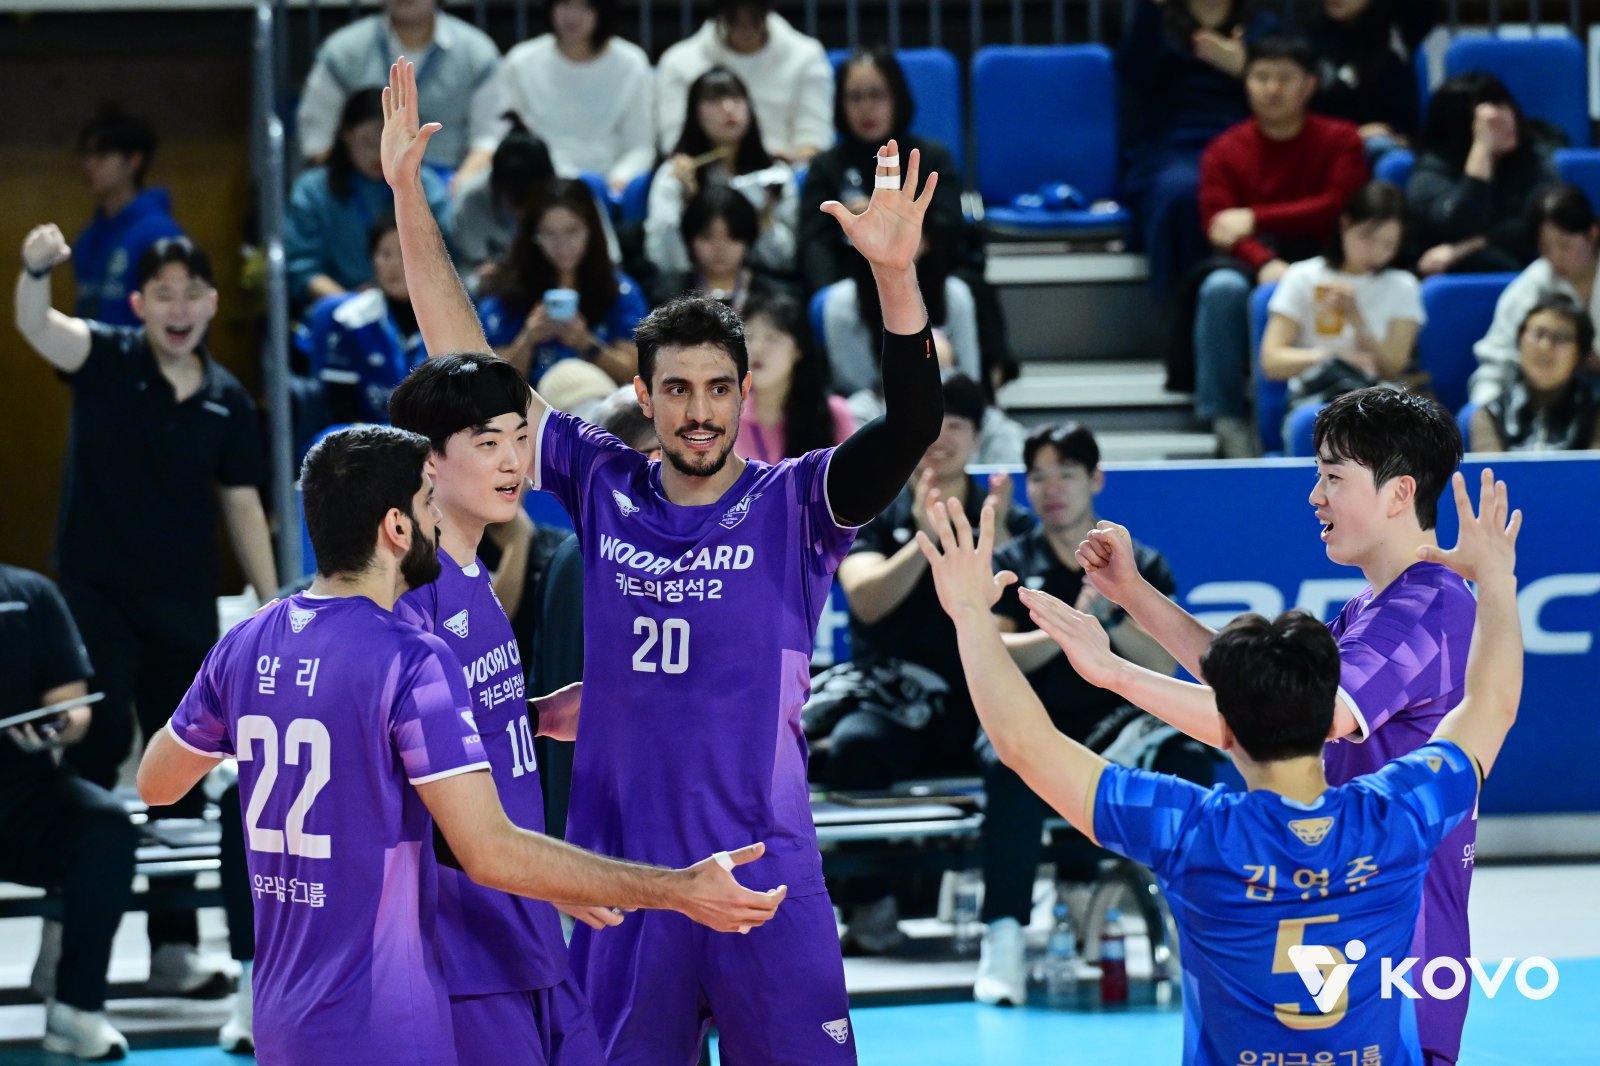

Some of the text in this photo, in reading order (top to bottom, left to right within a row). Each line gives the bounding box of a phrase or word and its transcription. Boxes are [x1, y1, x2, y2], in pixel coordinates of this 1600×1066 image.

[673, 544, 755, 573] CARD
[632, 615, 690, 674] 20
[505, 714, 537, 778] 10
[237, 714, 332, 859] 22
[1271, 914, 1349, 1030] 5
